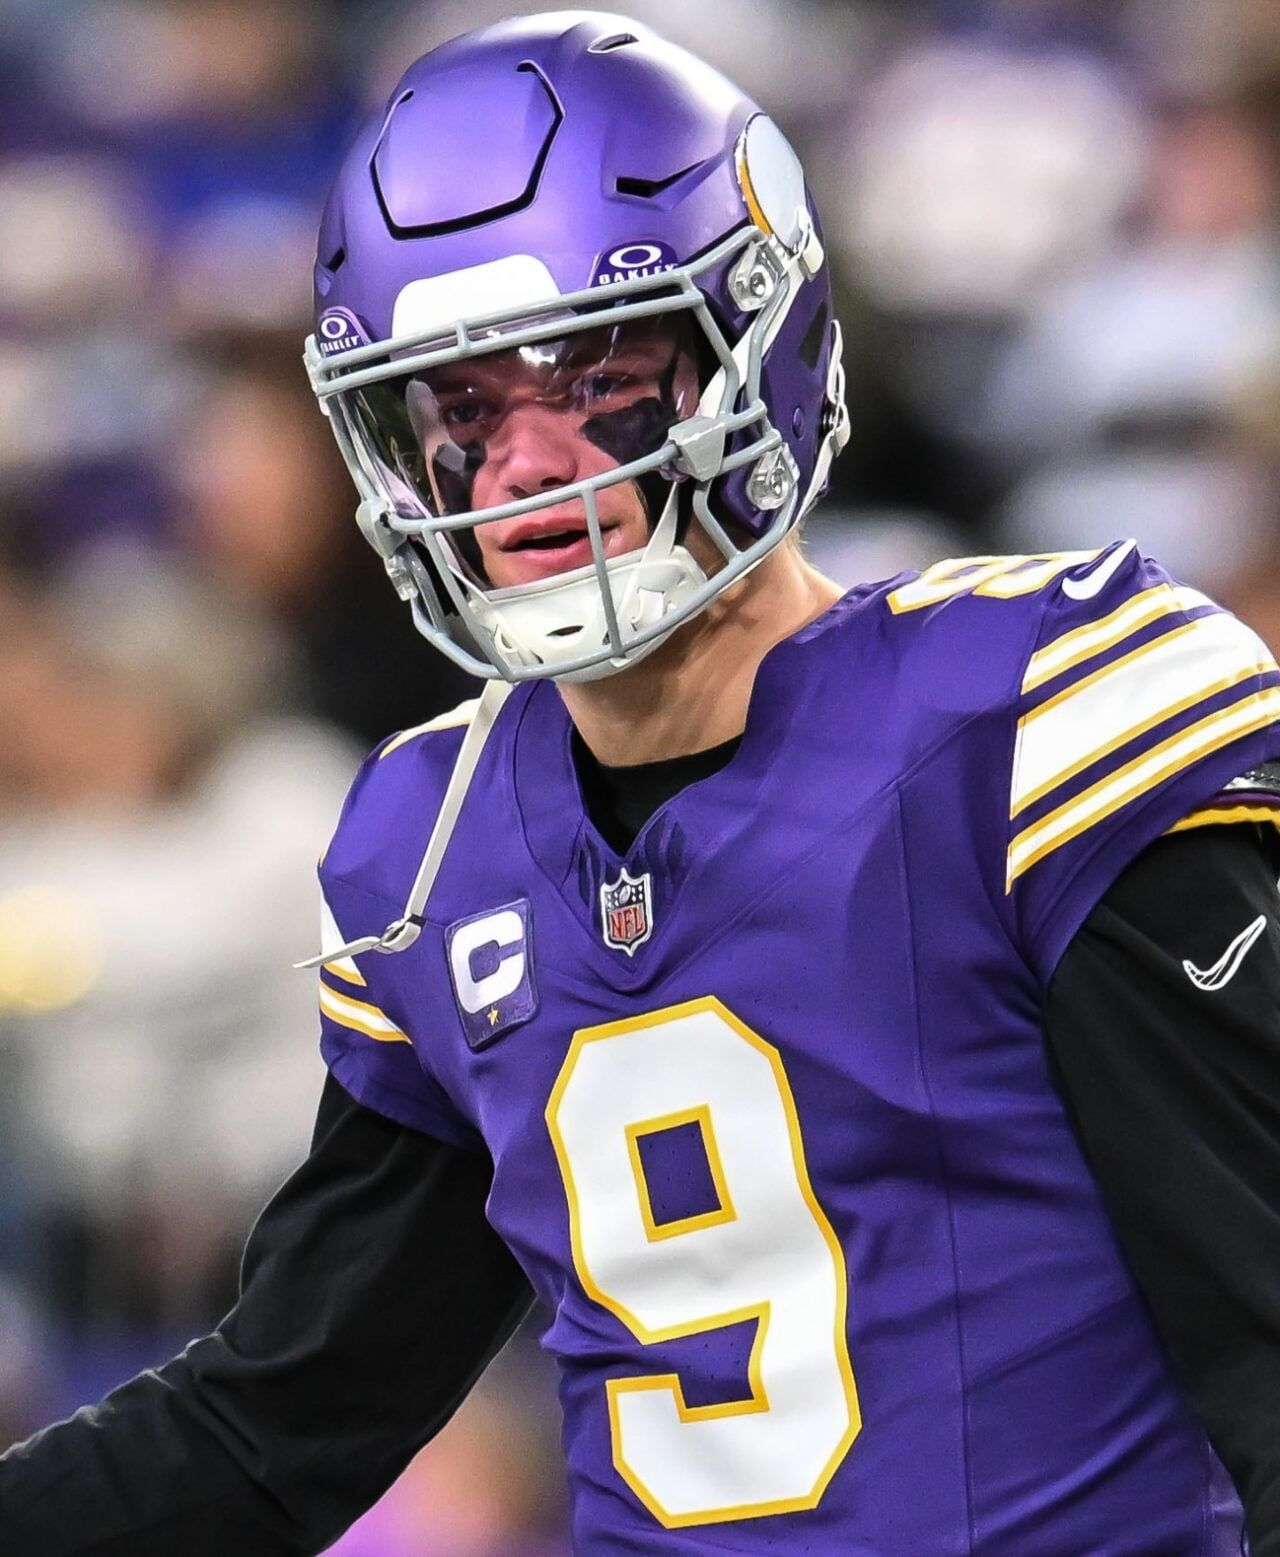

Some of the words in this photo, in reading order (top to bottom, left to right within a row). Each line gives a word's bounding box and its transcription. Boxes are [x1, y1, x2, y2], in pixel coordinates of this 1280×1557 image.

[598, 263, 679, 285] OAKLEY
[320, 335, 360, 353] OAKLEY
[610, 907, 644, 940] NFL
[451, 910, 525, 1015] C
[544, 995, 863, 1530] 9
